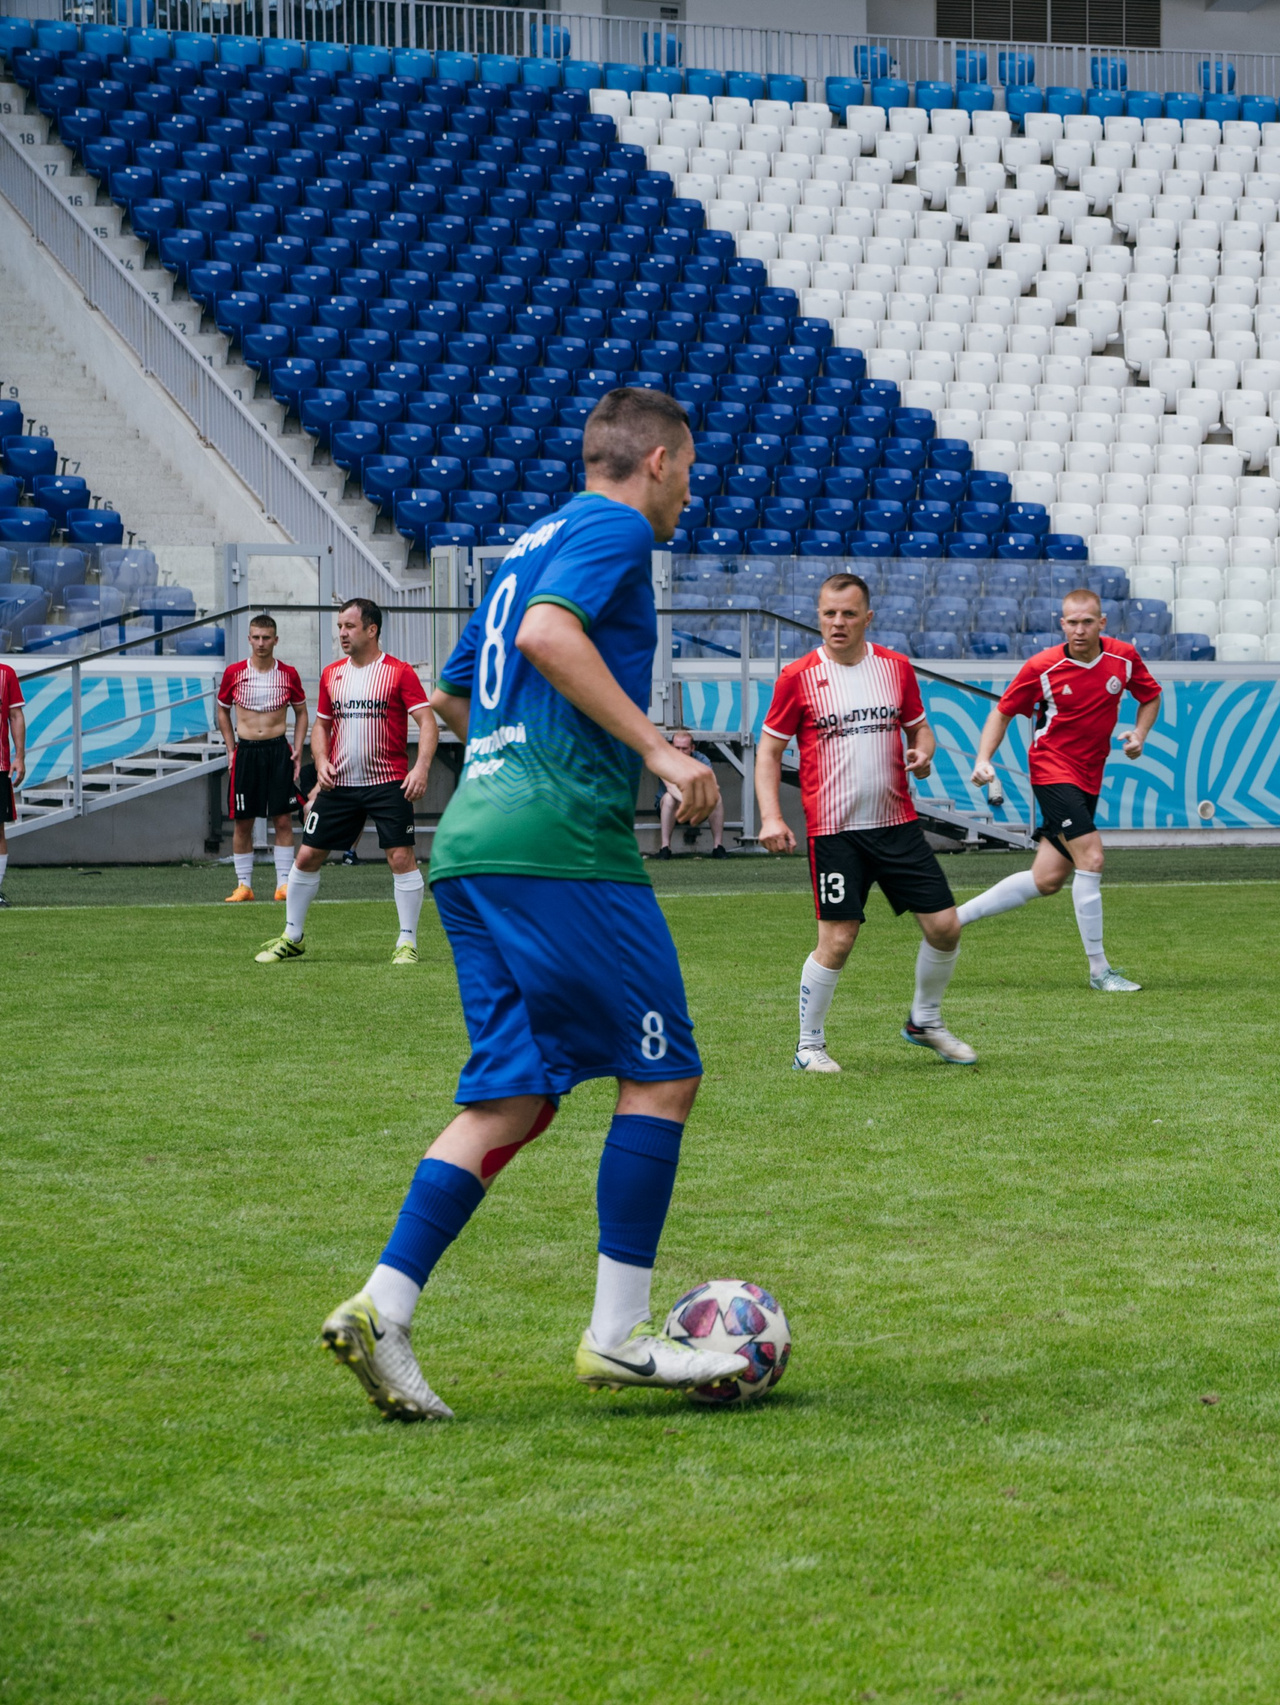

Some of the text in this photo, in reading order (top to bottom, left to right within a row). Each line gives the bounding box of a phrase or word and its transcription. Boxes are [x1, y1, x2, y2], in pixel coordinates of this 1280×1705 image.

[19, 133, 35, 145] 18
[43, 164, 58, 176] 17
[67, 195, 83, 207] 16
[93, 227, 108, 239] 15
[9, 386, 19, 399] 9
[39, 425, 49, 437] 8
[72, 462, 81, 474] 7
[479, 572, 517, 710] 8
[235, 793, 245, 811] 11
[819, 872, 846, 904] 13
[641, 1010, 668, 1061] 8
